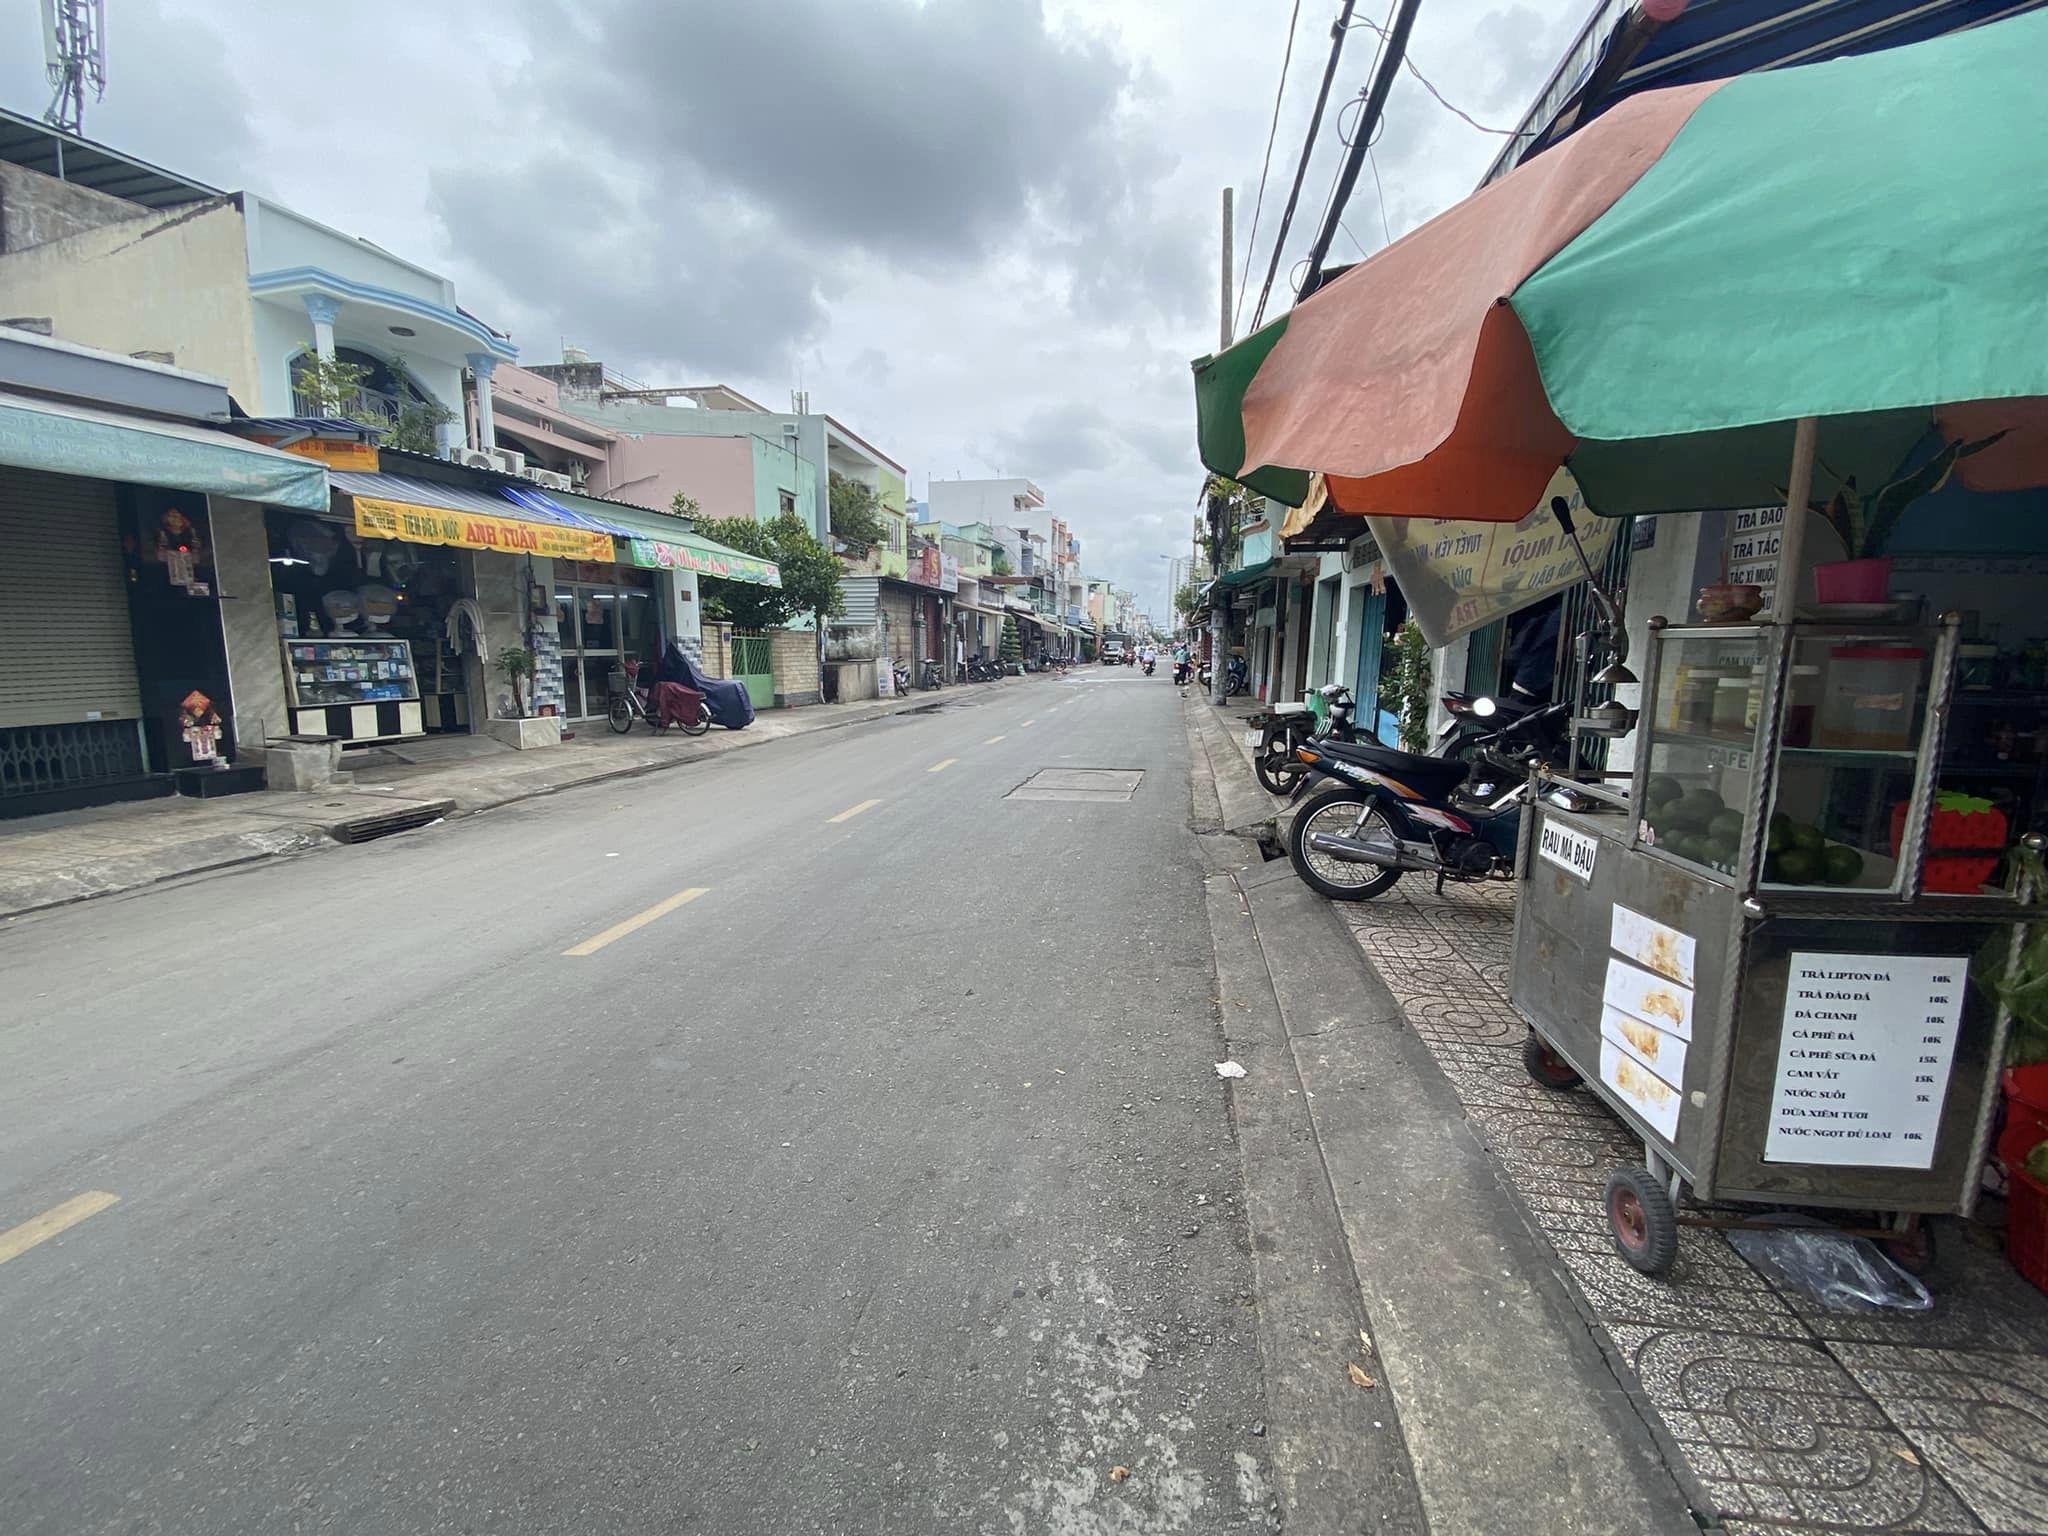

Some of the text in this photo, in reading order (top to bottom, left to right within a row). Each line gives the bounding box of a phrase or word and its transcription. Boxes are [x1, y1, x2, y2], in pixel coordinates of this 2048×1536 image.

[466, 522, 498, 546] ANH
[500, 523, 538, 550] TUẤN
[1542, 828, 1594, 873] RAU MÁ ĐẬU
[1828, 971, 1872, 981] LIPTON
[1932, 975, 1951, 983] 10K
[1929, 996, 1948, 1004] 10K
[1814, 1011, 1857, 1021] CHANH
[1926, 1016, 1945, 1024] 10K
[1792, 1029, 1808, 1039] CÀ
[1811, 1030, 1836, 1040] PHÊ
[1923, 1036, 1942, 1044] 10K
[1790, 1048, 1806, 1058] CÀ
[1808, 1050, 1832, 1059] PHÊ
[1919, 1056, 1938, 1064] 15K
[1787, 1069, 1813, 1078] CAM
[1784, 1088, 1817, 1098] NƯỚC
[1916, 1094, 1930, 1102] 5K
[1808, 1109, 1839, 1119] XIÊM
[1779, 1126, 1811, 1137] NƯỚC
[1904, 1132, 1922, 1141] 10K
